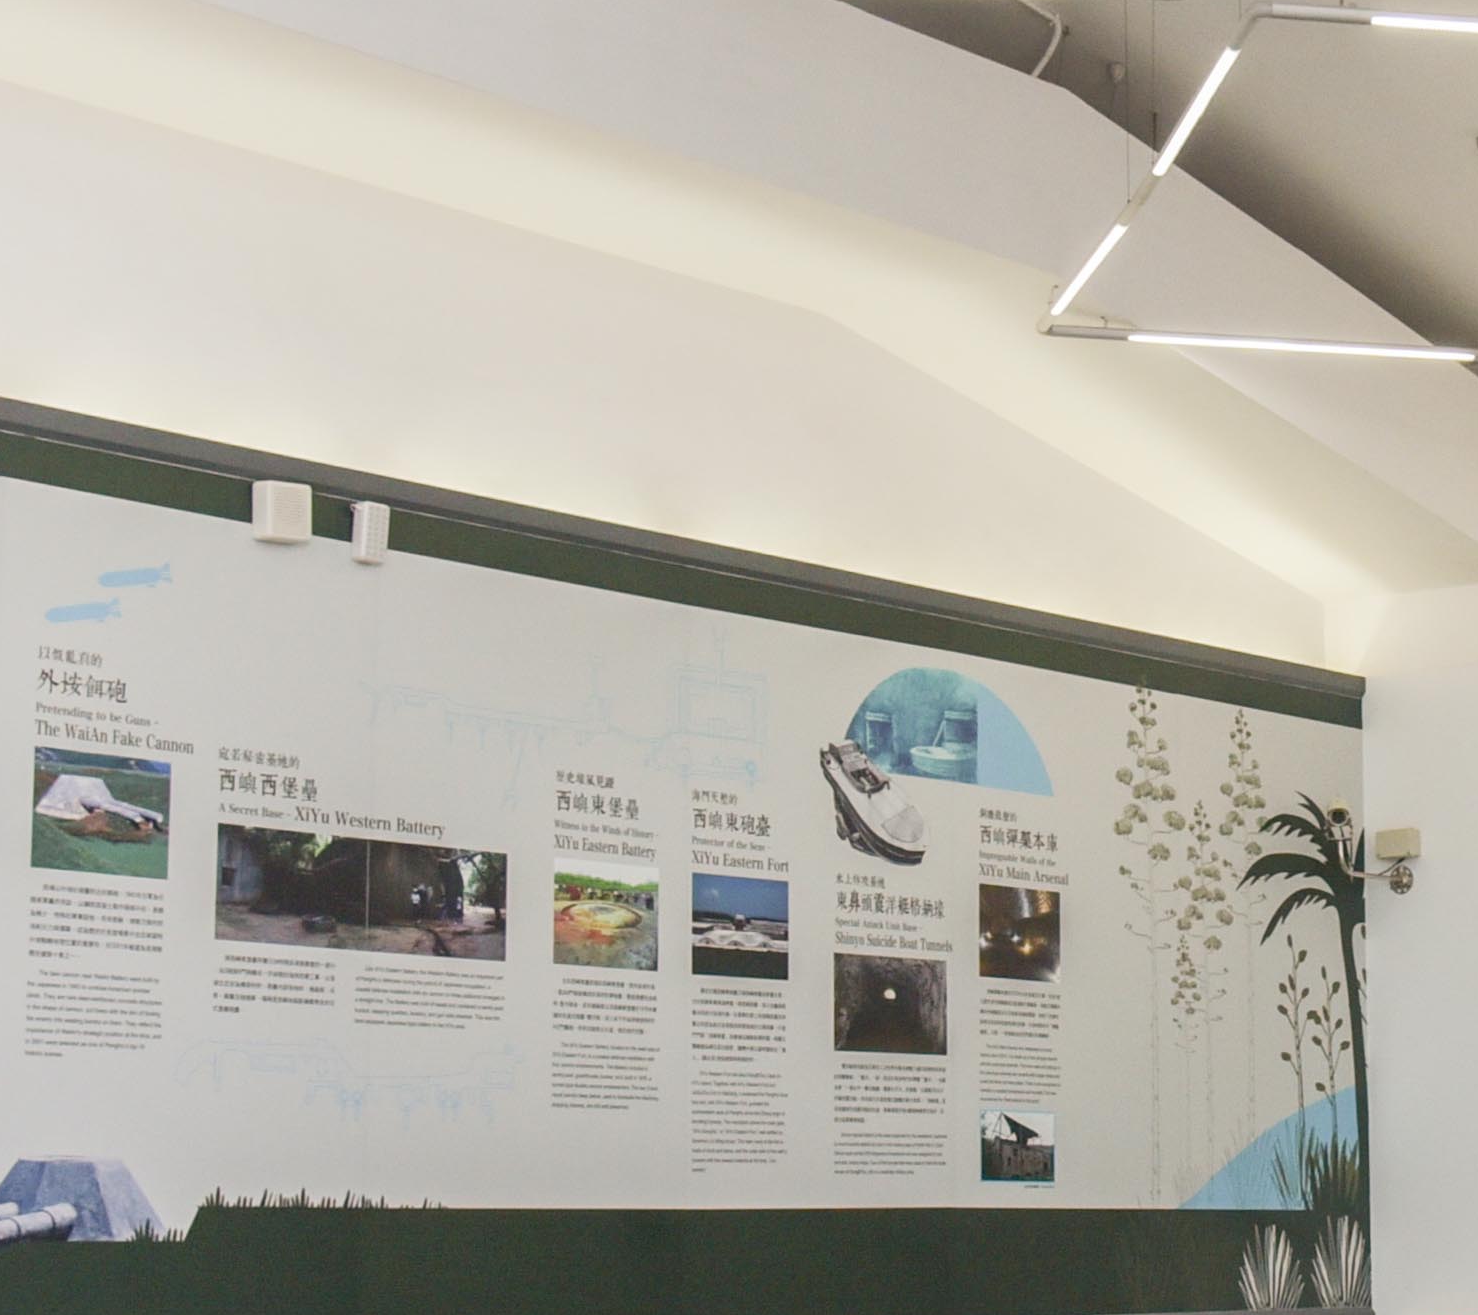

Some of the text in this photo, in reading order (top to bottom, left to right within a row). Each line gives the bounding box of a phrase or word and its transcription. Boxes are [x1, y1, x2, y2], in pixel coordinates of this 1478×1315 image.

[35, 701, 93, 721] Pretending
[96, 711, 107, 721] to
[109, 711, 122, 723] be
[125, 715, 151, 727] Guns
[35, 719, 195, 755] The WaiAn Fake Cannon
[229, 803, 258, 817] Secret
[262, 807, 284, 819] Base
[294, 806, 330, 825] XiYu
[335, 811, 391, 831] Western
[396, 817, 446, 840] Battery
[554, 833, 657, 862] XiYu Eastern Battery
[692, 850, 789, 873] XiYu Eastern Fort
[978, 862, 1070, 886] XiYu Main Arsenal
[866, 933, 897, 948] Suicide
[899, 935, 918, 950] Boat
[920, 937, 954, 953] Tunnels
